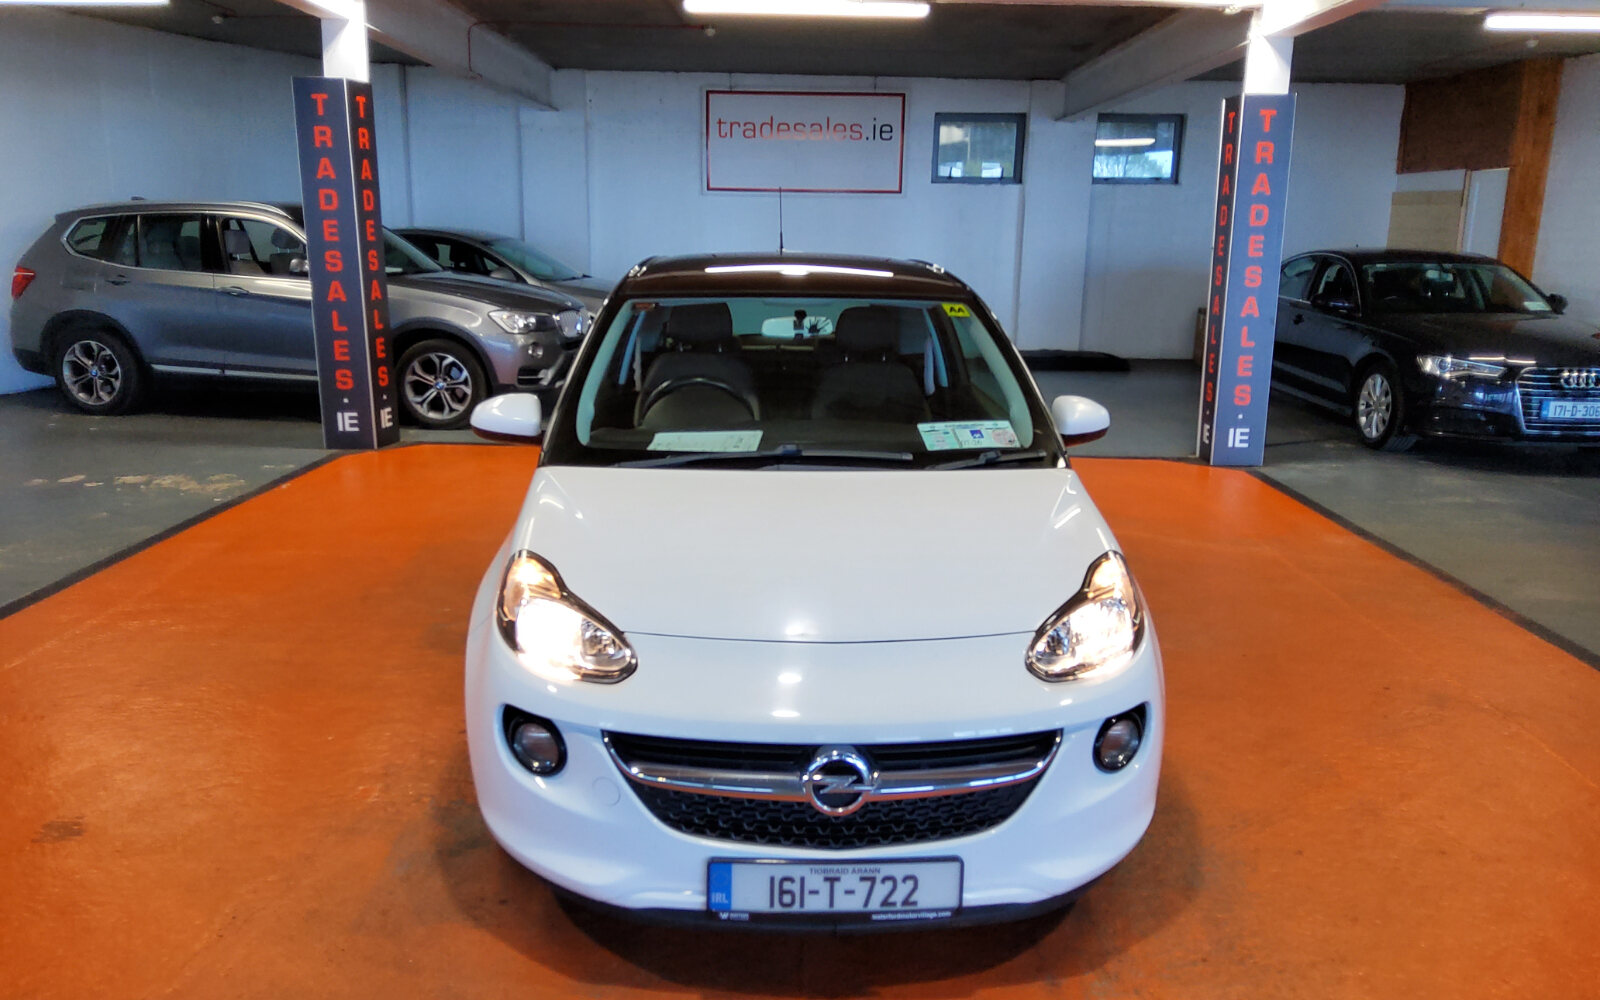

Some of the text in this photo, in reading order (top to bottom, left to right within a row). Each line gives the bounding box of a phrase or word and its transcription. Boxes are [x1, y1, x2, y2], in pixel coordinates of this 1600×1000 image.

[716, 116, 893, 141] tradesales.ie
[1202, 111, 1236, 445] TRADESALES.E
[711, 892, 729, 904] IRL
[769, 874, 919, 909] 161-T-722
